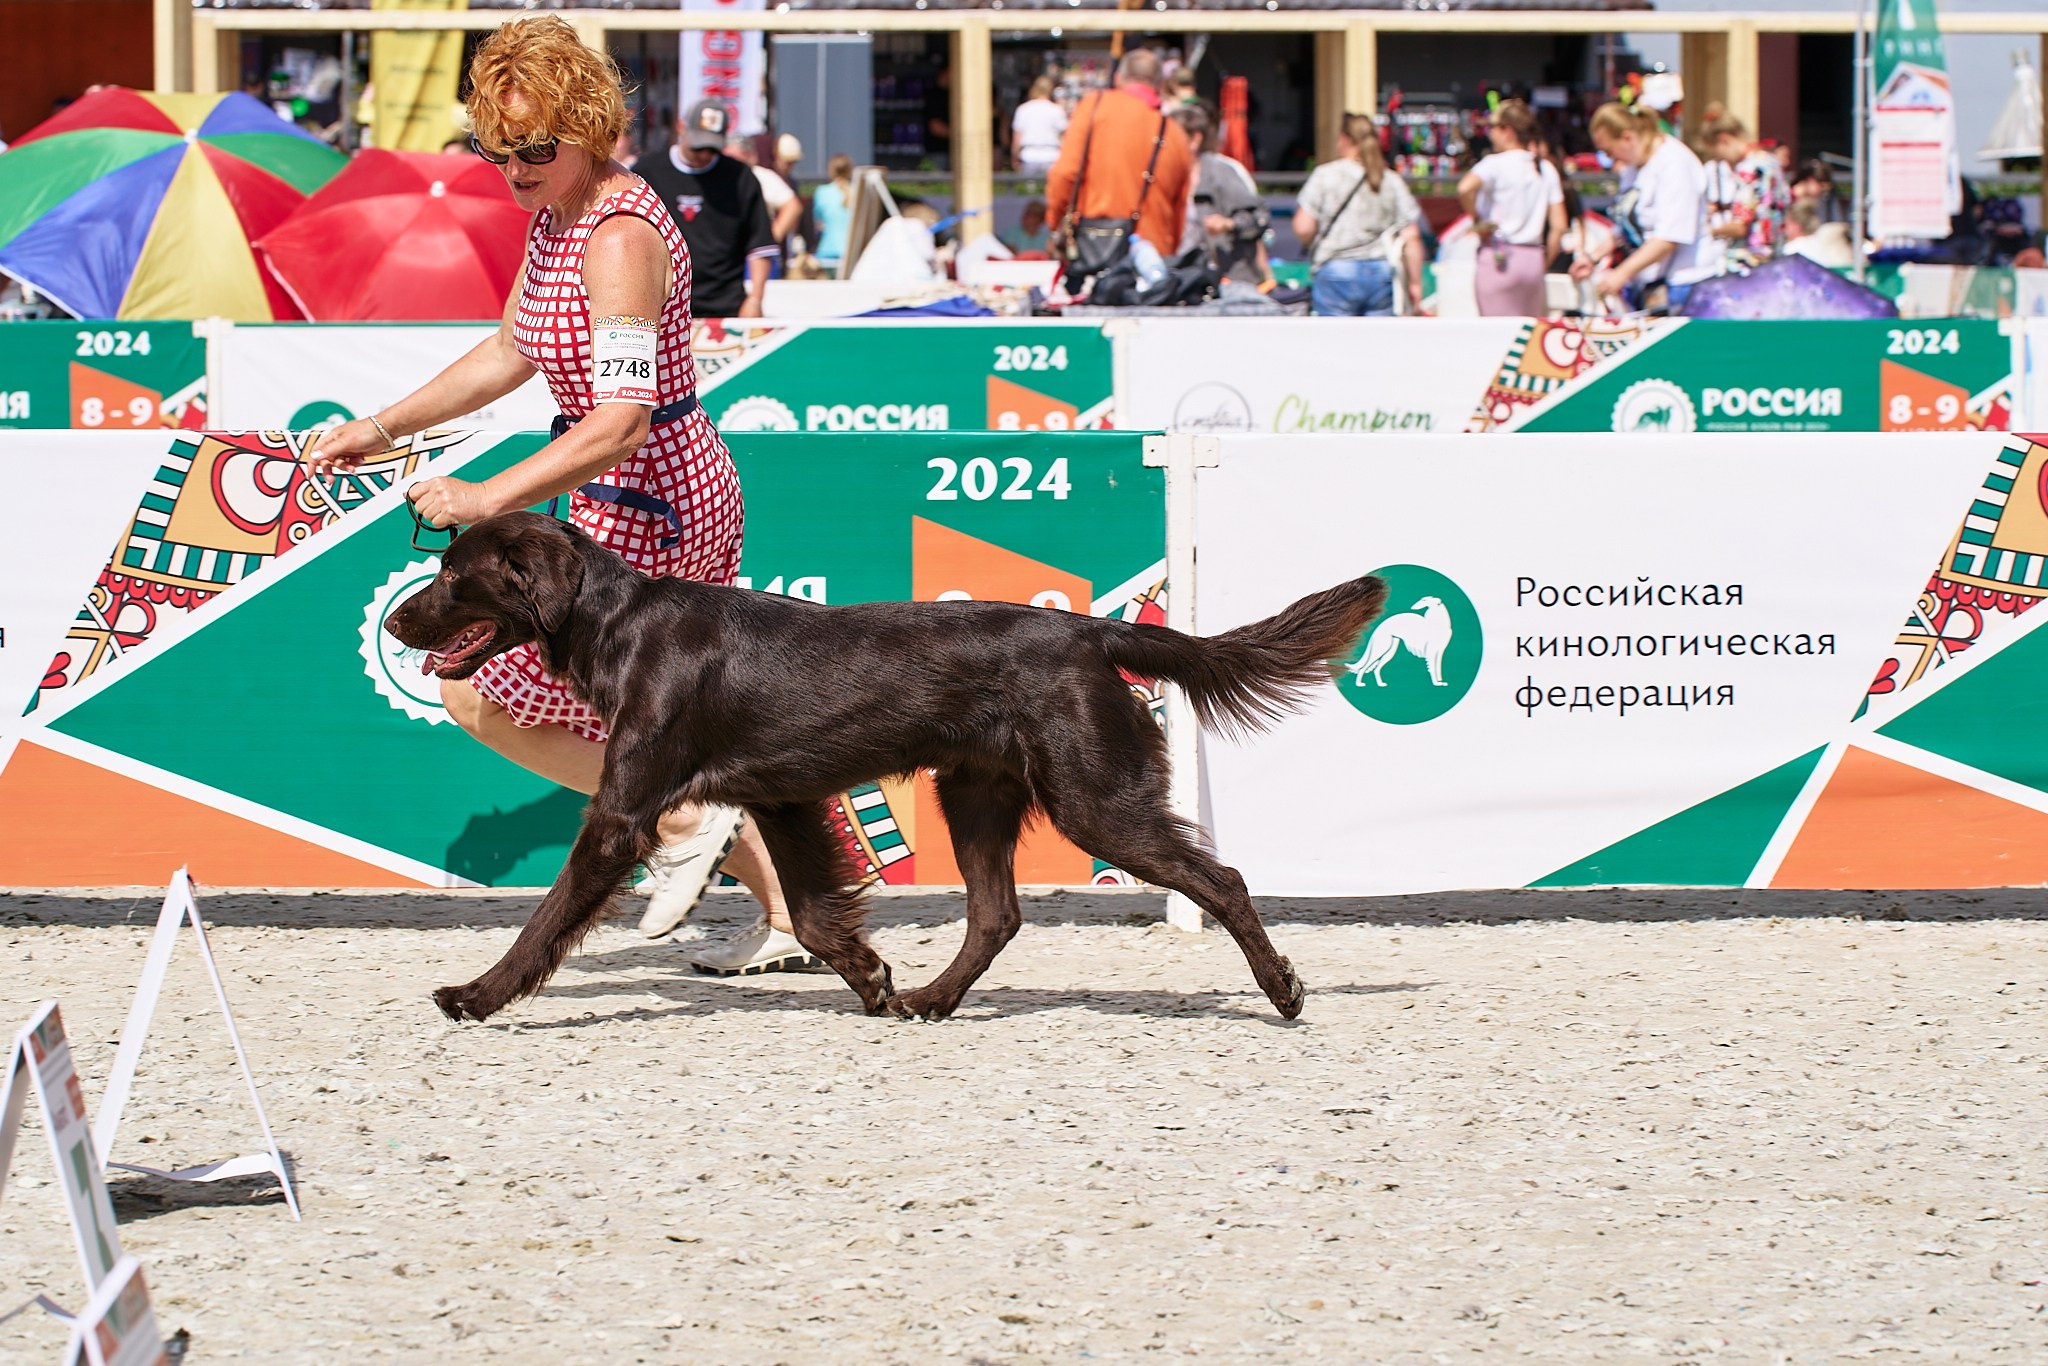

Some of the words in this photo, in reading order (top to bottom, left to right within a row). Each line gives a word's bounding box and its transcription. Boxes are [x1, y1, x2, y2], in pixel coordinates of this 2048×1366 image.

[75, 330, 151, 357] 2024
[1887, 329, 1960, 354] 2024
[600, 359, 650, 379] 2748
[993, 345, 1068, 371] 2024
[621, 389, 653, 399] 9.06.2024
[1702, 387, 1842, 416] РОССИЯ
[806, 404, 949, 431] РОССИЯ
[1273, 394, 1434, 432] Champion
[926, 457, 1072, 501] 2024
[1516, 576, 1744, 607] Российская
[1516, 633, 1836, 657] кинологическая
[1515, 675, 1734, 717] федерация
